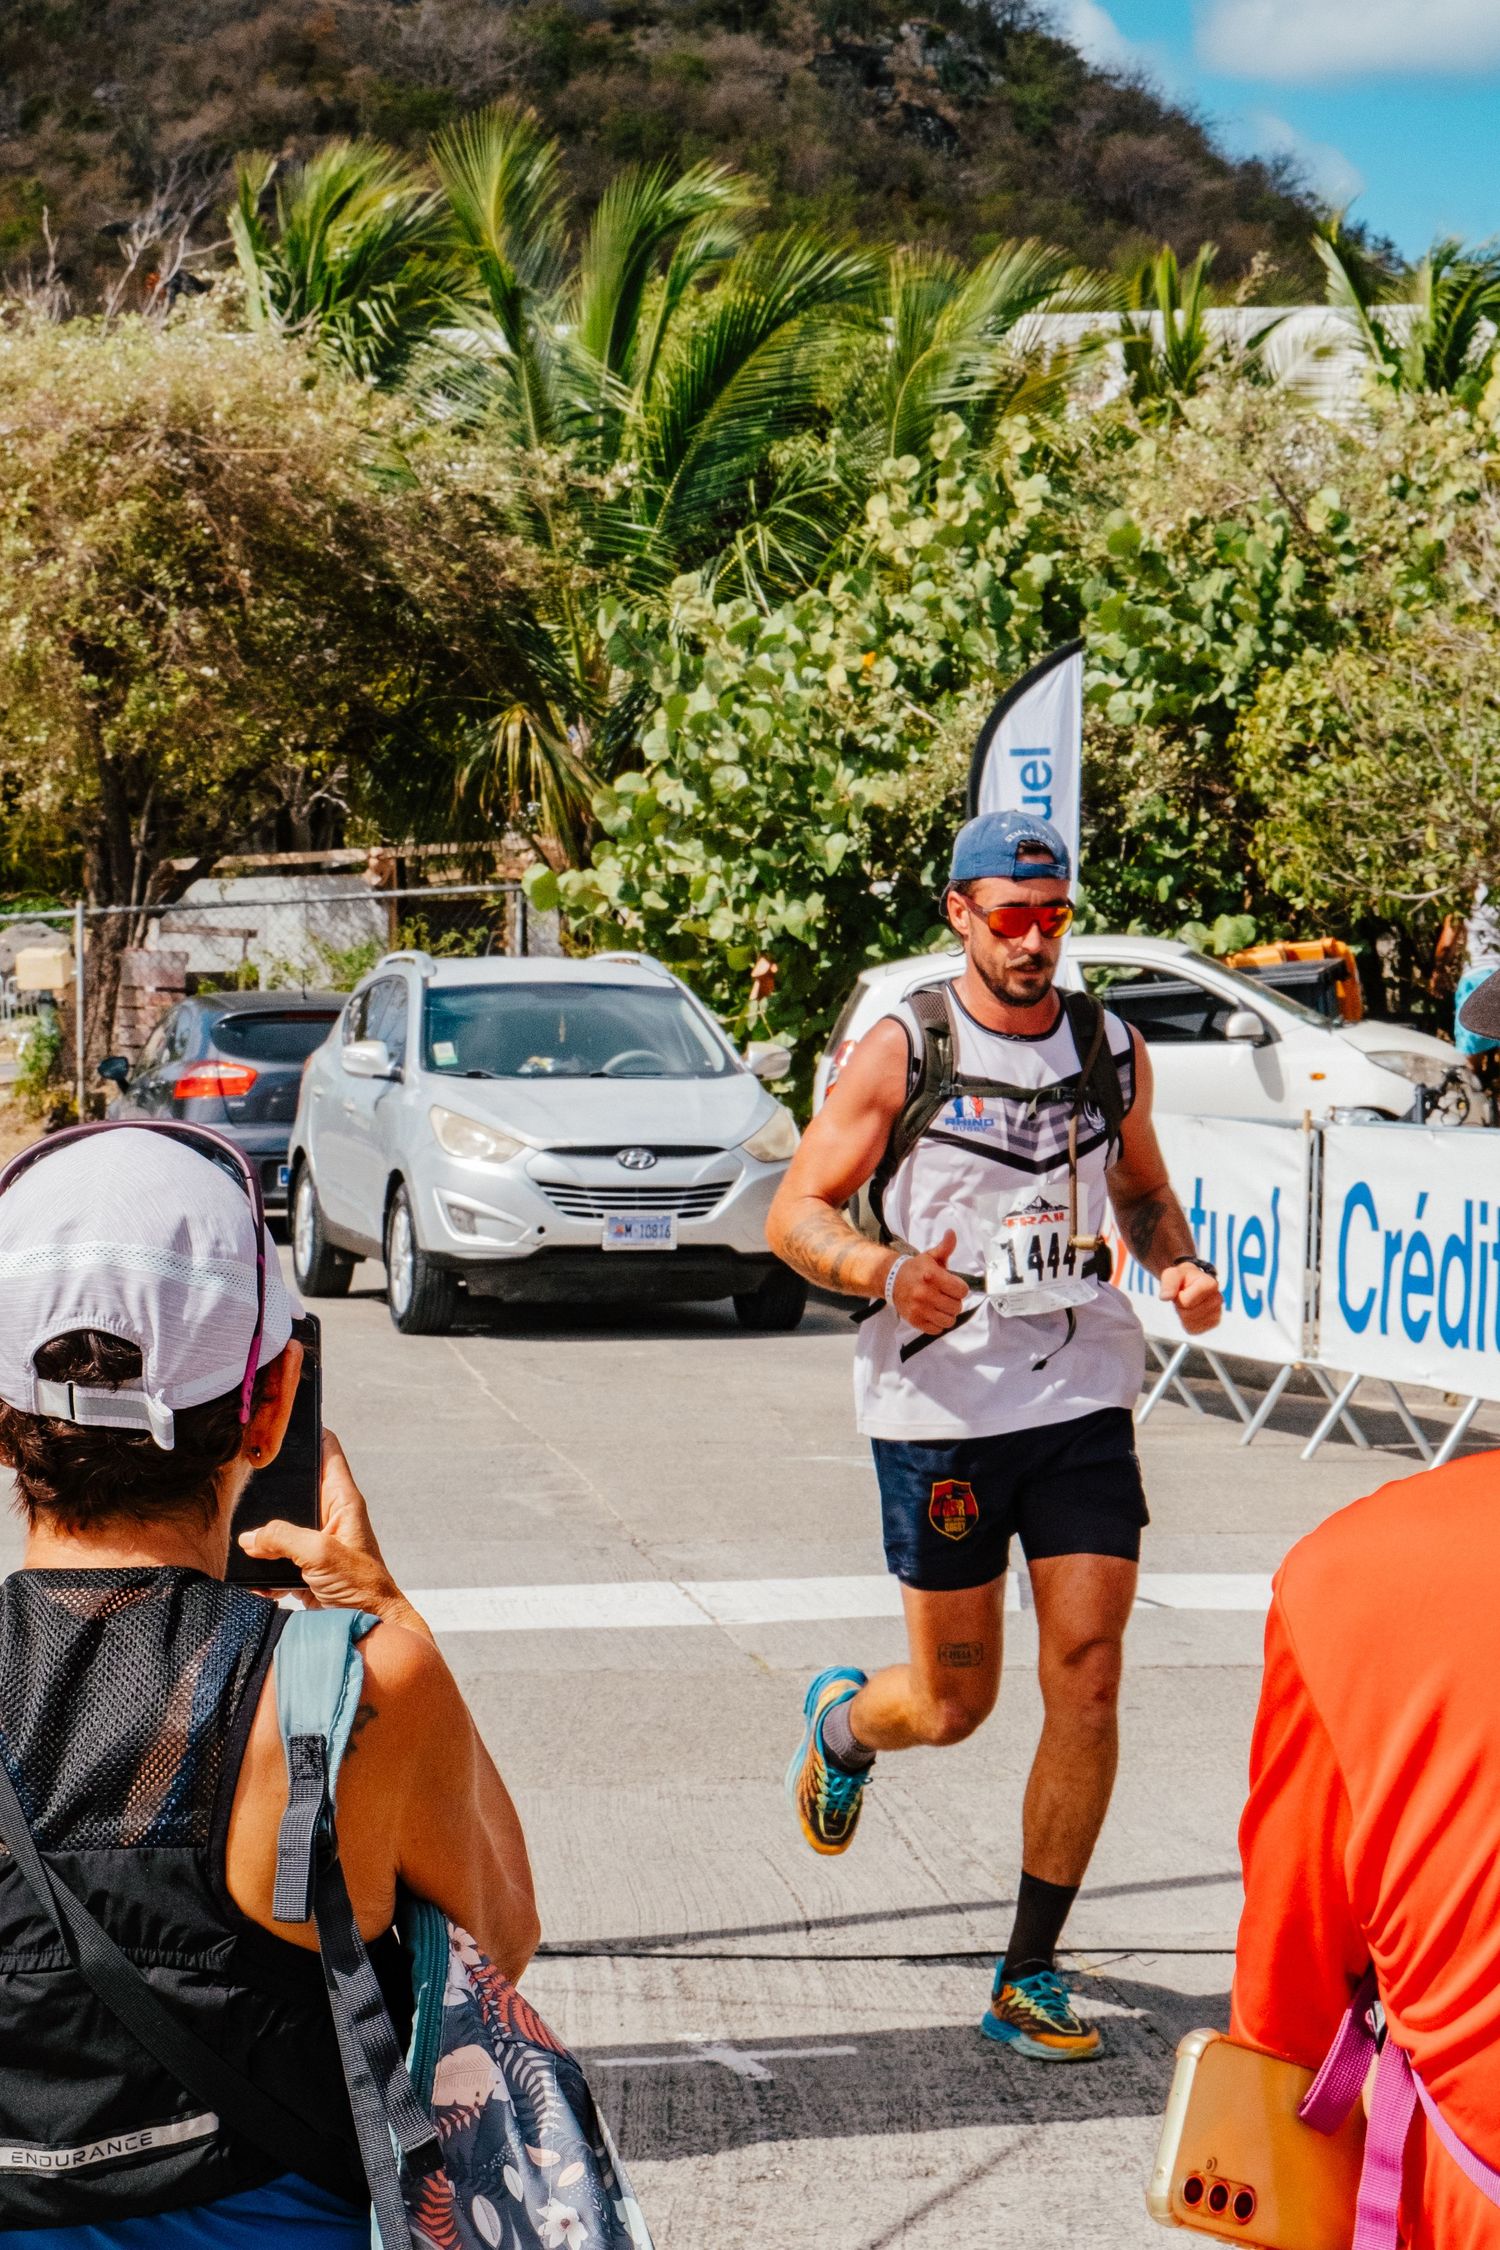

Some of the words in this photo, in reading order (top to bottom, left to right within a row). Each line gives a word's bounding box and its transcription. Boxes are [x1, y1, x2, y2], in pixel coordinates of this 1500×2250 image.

[944, 1117, 995, 1127] RHINO
[1000, 1232, 1077, 1286] 1444
[1338, 1181, 1500, 1353] Crédi
[11, 2132, 153, 2168] ENDURANCE
